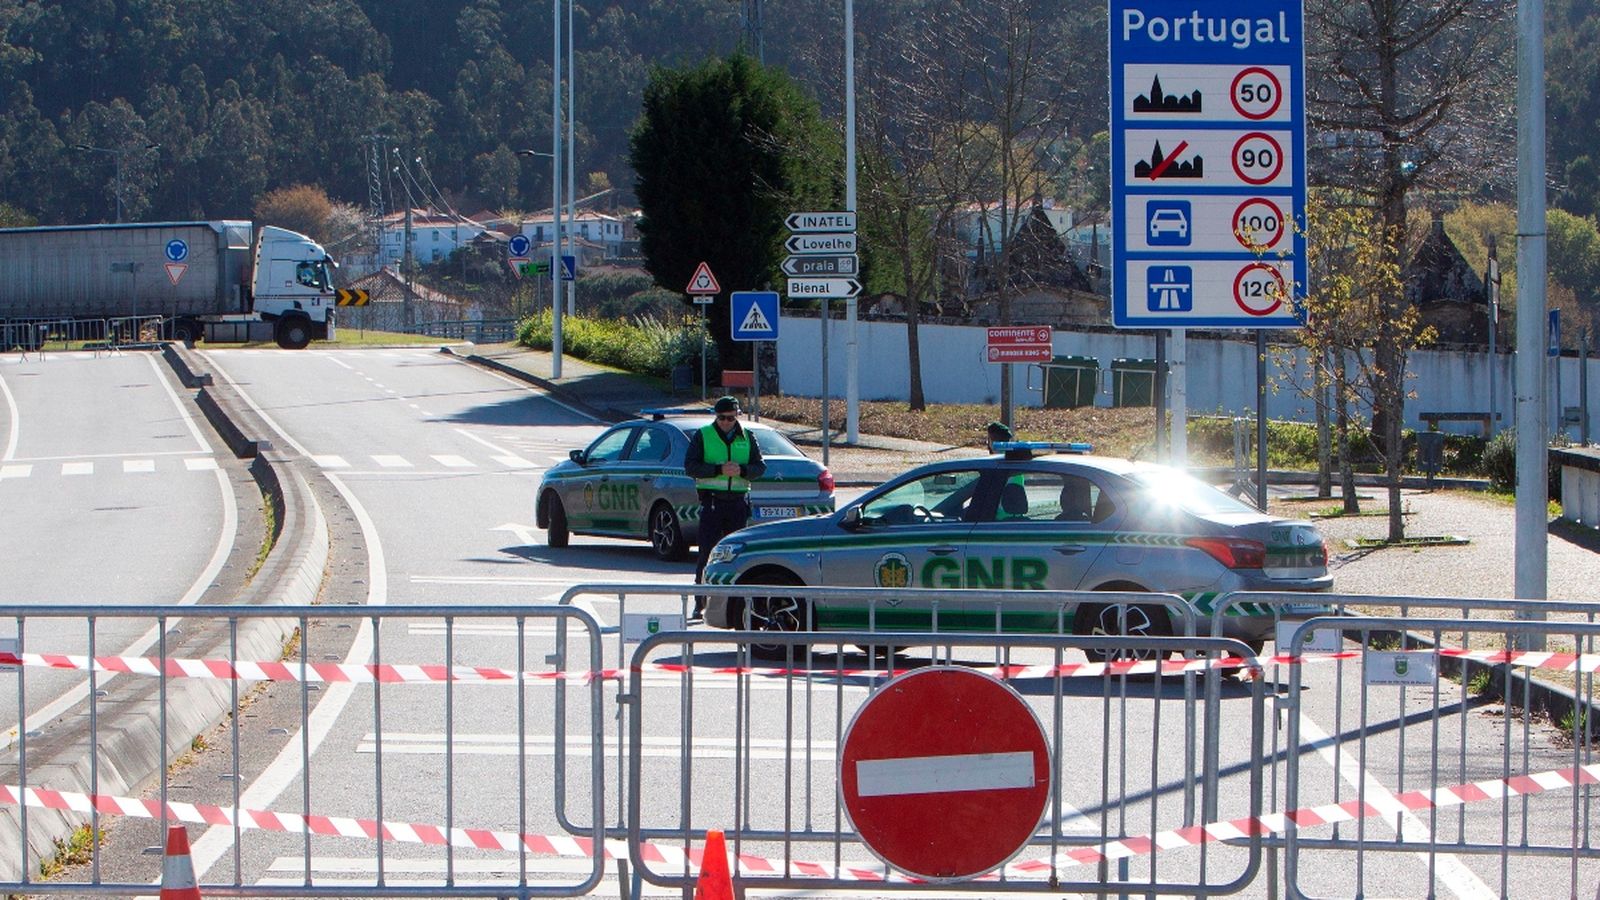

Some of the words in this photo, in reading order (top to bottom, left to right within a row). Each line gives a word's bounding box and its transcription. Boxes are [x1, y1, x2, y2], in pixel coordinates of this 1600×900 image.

[1123, 9, 1290, 49] Portugal
[1240, 84, 1272, 103] 50
[1241, 149, 1273, 168] 90
[803, 216, 852, 227] INATEL
[1240, 216, 1277, 232] 100
[803, 238, 852, 249] Lovelhe
[803, 260, 834, 272] praia
[791, 282, 830, 293] Bienal
[598, 484, 640, 510] GNR
[920, 556, 1049, 590] GNR
